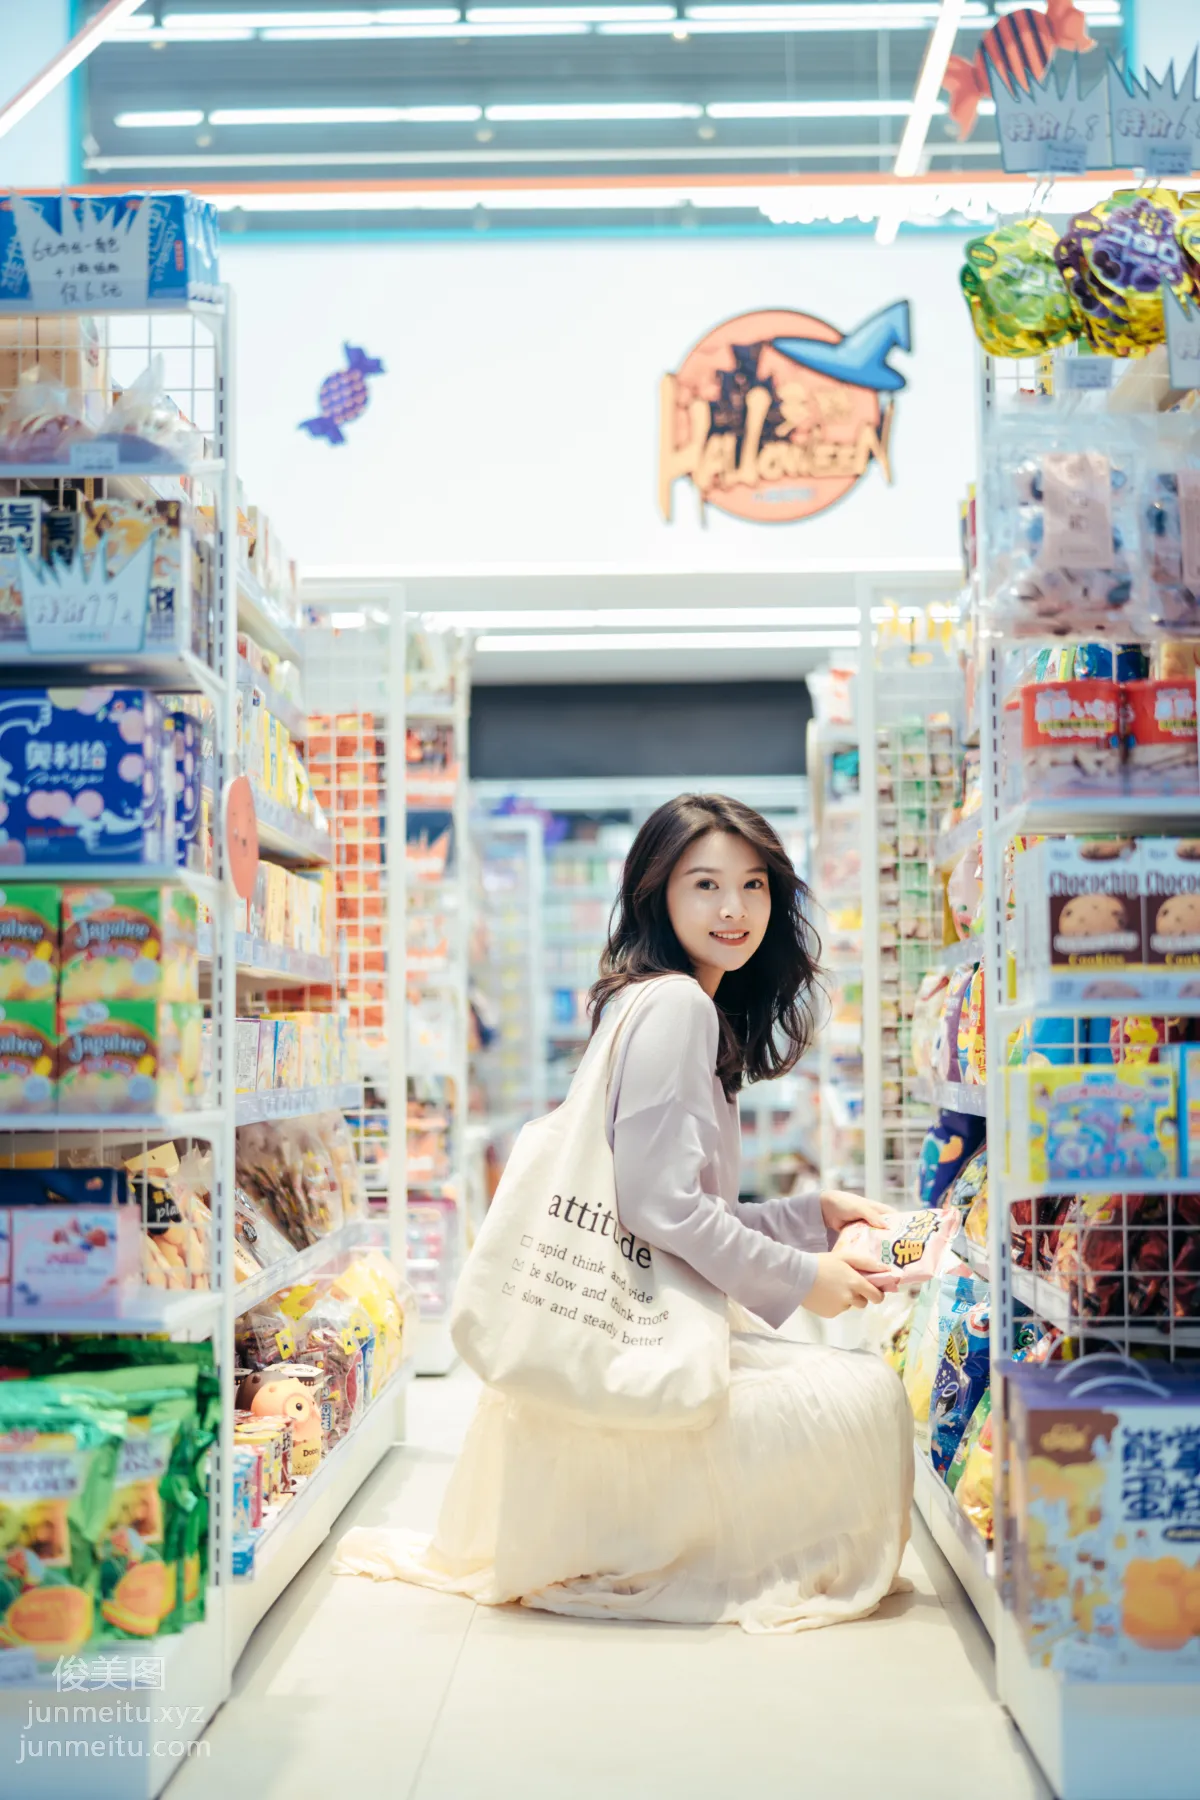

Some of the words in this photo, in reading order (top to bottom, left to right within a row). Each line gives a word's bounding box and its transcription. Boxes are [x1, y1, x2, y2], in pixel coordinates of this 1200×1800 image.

[529, 1263, 541, 1279] be
[544, 1270, 577, 1292] slow
[581, 1285, 607, 1302] and
[610, 1296, 635, 1323] think
[637, 1309, 670, 1326] more
[536, 1241, 568, 1261] rapid
[572, 1254, 606, 1275] think
[611, 1269, 628, 1291] and
[521, 1289, 546, 1308] slow
[550, 1301, 579, 1321] and
[582, 1312, 619, 1340] steady
[621, 1331, 664, 1347] better
